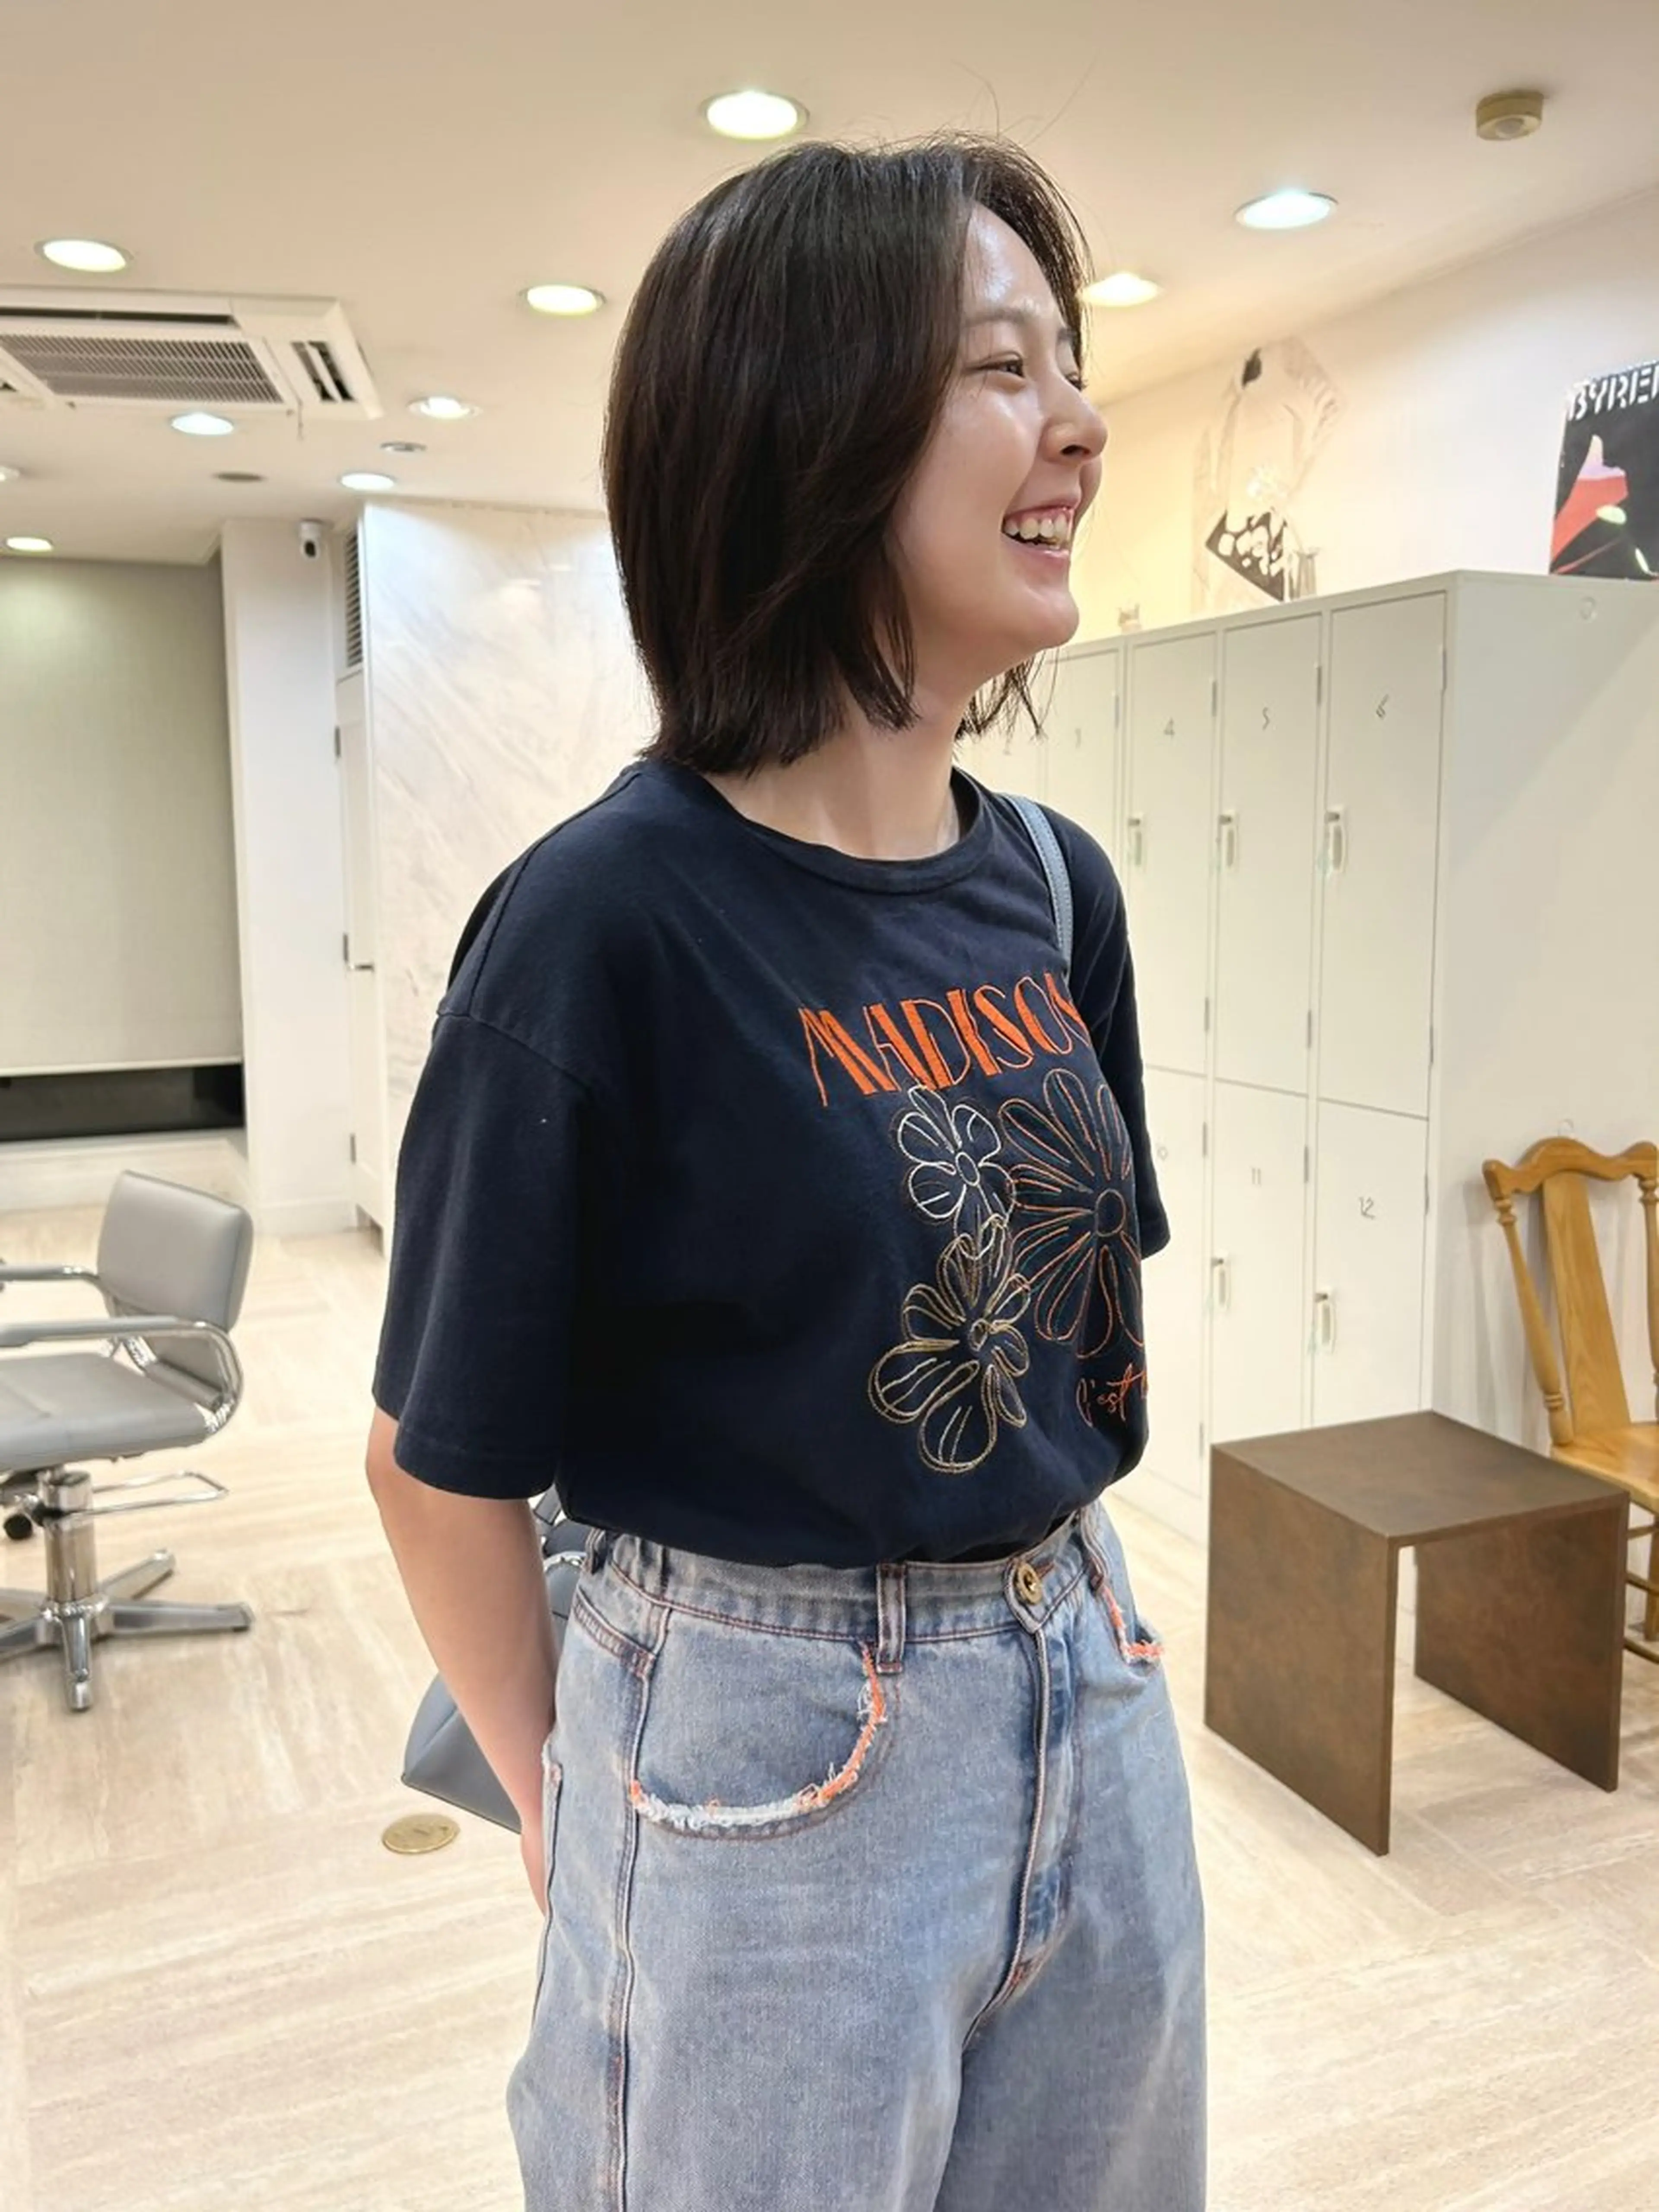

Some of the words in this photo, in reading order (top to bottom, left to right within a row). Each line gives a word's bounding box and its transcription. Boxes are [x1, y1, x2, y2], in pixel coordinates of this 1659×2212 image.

[1261, 706, 1271, 732] 5
[1375, 693, 1389, 721] 6
[1163, 716, 1175, 741] 4
[1251, 1167, 1262, 1186] 11
[1358, 1196, 1376, 1220] 12
